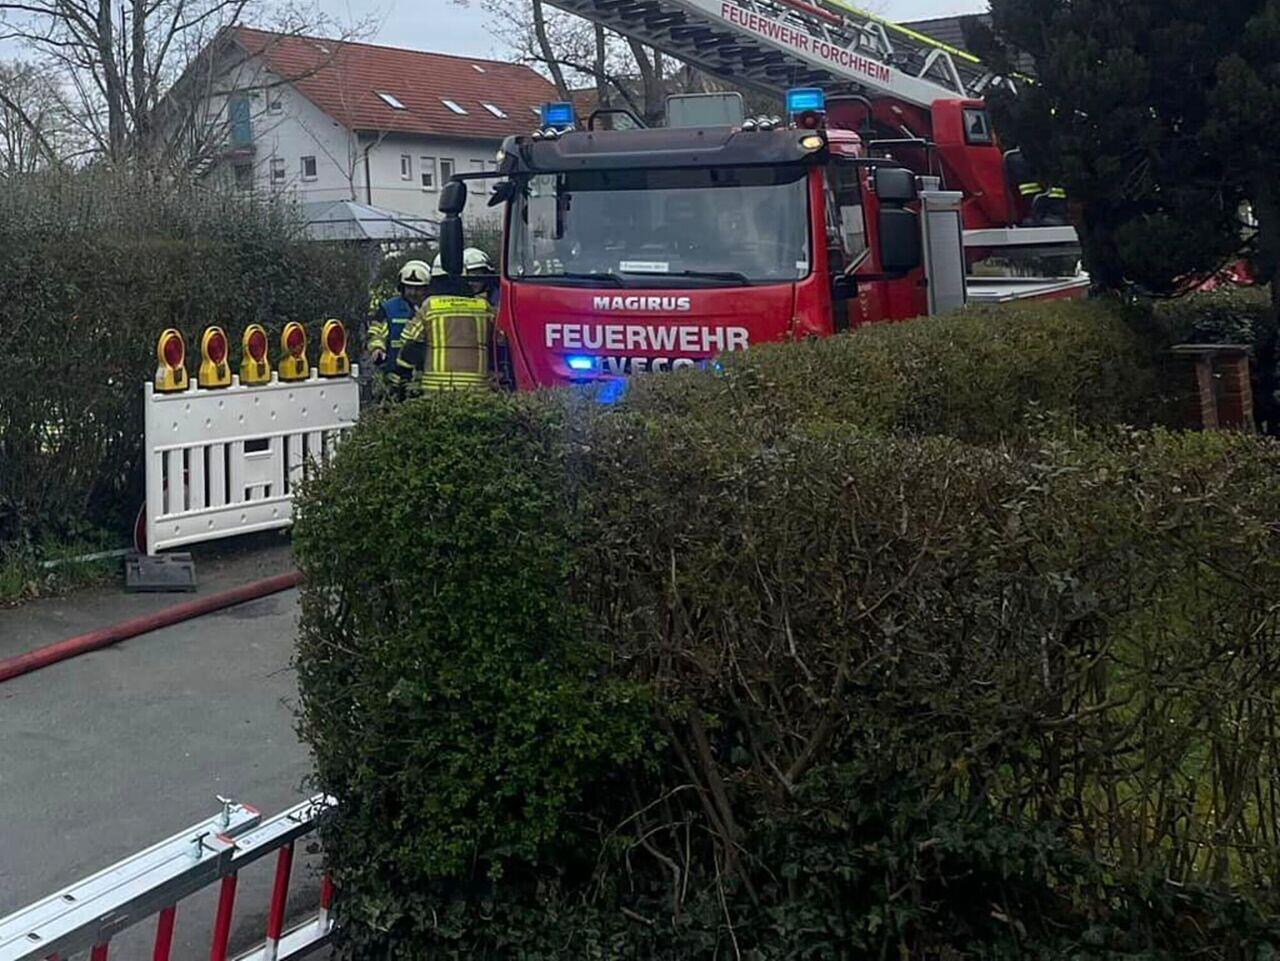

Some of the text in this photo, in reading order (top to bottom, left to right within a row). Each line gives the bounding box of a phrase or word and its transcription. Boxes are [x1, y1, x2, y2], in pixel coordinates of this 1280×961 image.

[721, 3, 891, 83] FEUERWEHR FORCHHEIM
[593, 296, 690, 311] MAGIRUS
[545, 323, 750, 352] FEUERWEHR
